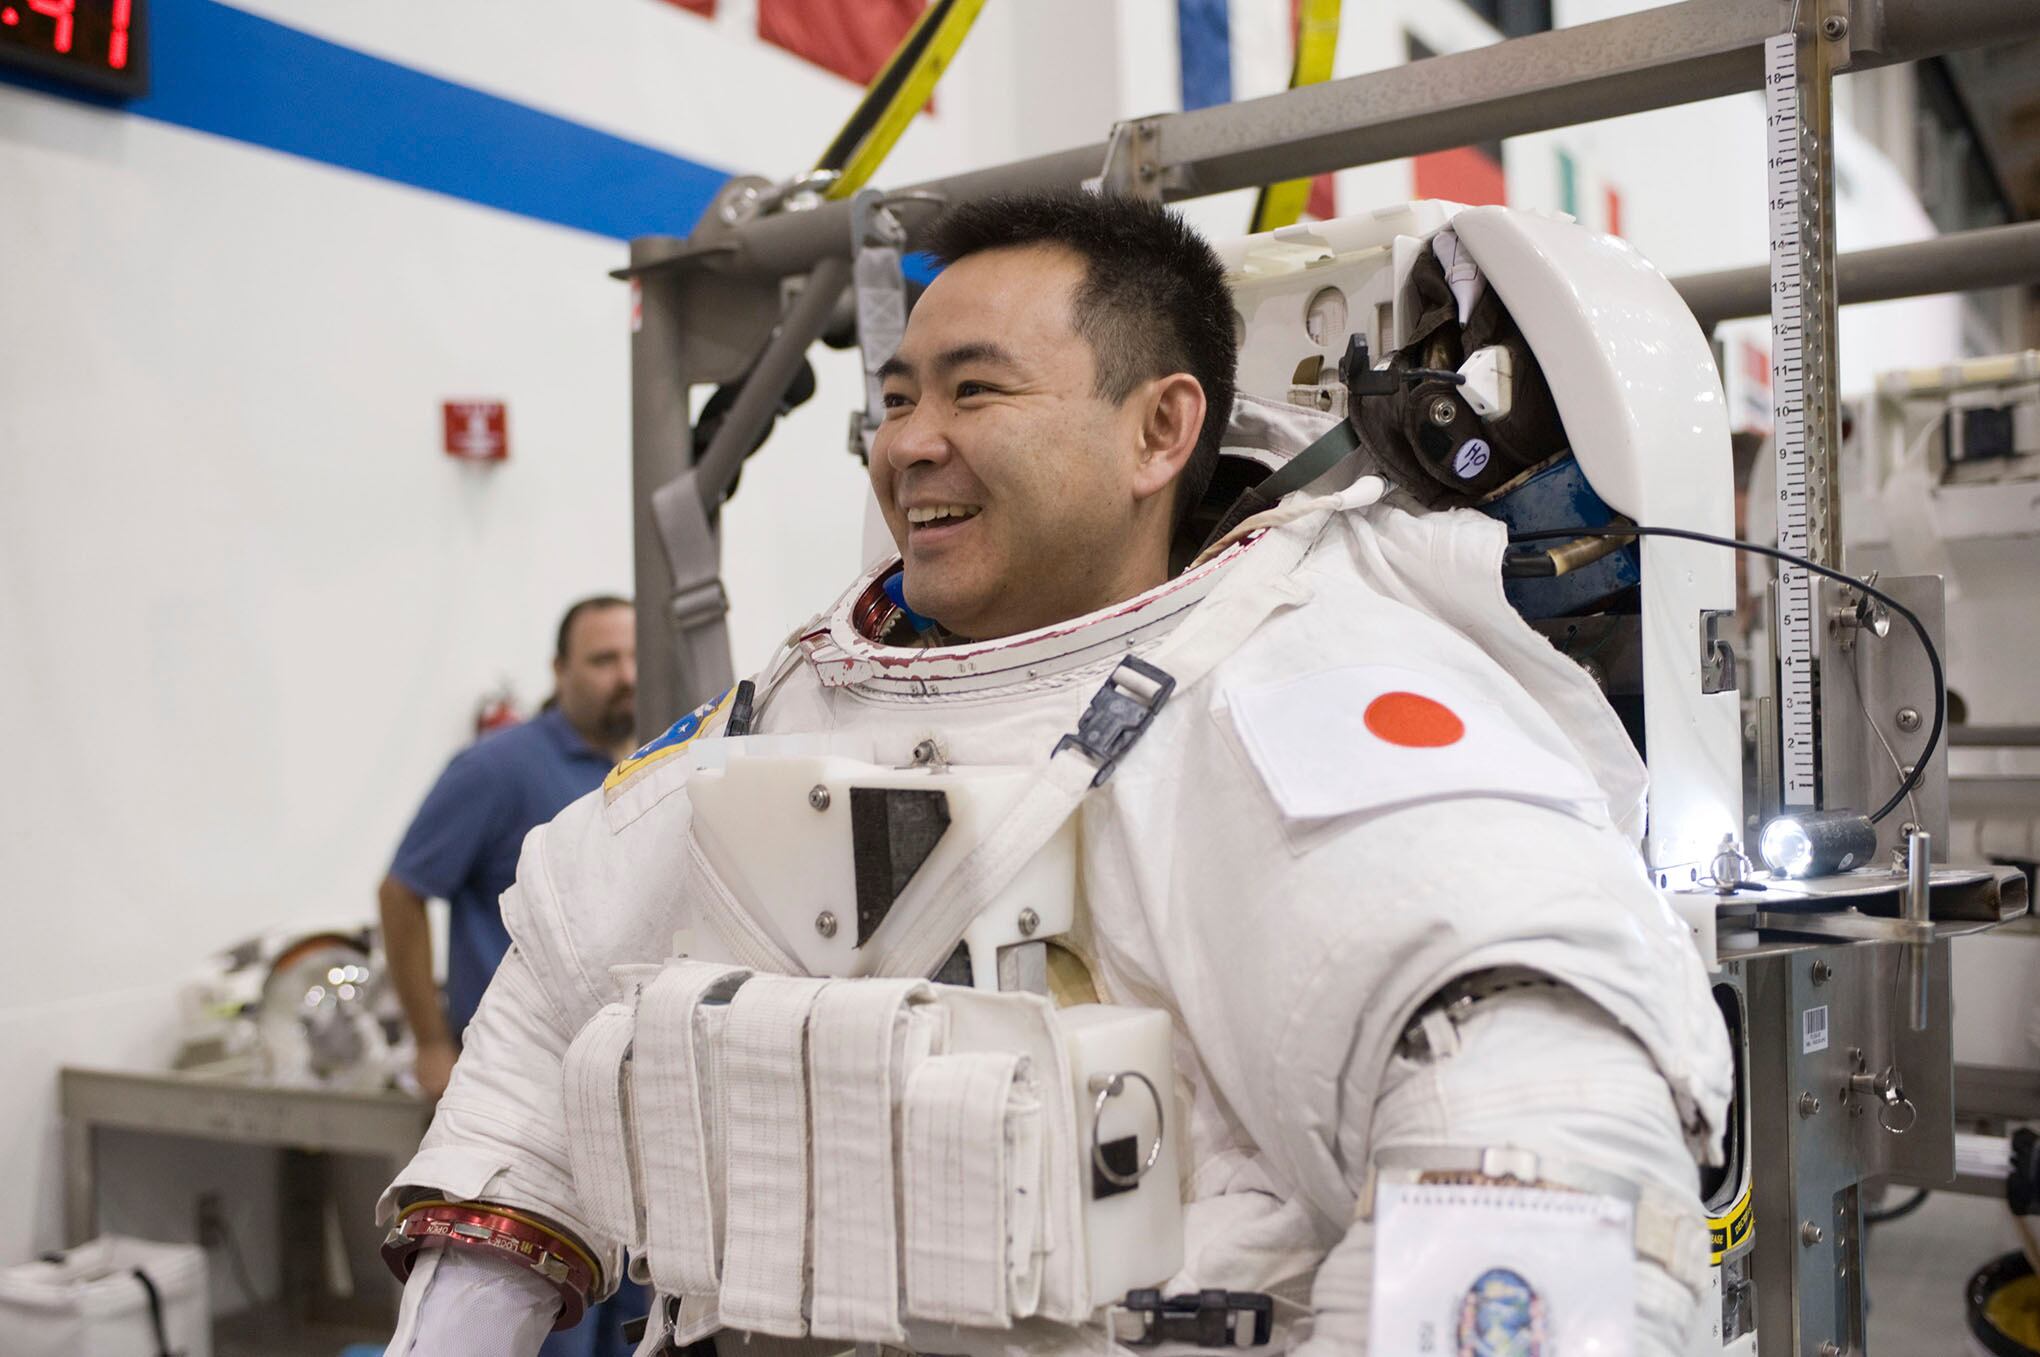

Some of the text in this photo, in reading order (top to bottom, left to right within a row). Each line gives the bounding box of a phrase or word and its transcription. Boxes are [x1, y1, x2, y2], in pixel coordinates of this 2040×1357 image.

[1767, 73, 1781, 85] 18
[1768, 115, 1782, 127] 17
[1769, 157, 1783, 169] 16
[1770, 199, 1784, 210] 15
[1772, 240, 1785, 251] 14
[1772, 282, 1787, 293] 13
[1774, 324, 1787, 335] 12
[1774, 365, 1787, 377] 11
[1776, 406, 1790, 418] 10
[1779, 448, 1787, 460] 9
[1780, 490, 1788, 501] 8
[1781, 531, 1789, 543] 7
[1782, 573, 1790, 584] 6
[1783, 615, 1791, 626] 5
[1785, 656, 1793, 667] 4
[1786, 698, 1794, 709] 3
[1787, 738, 1795, 749] 2
[1789, 780, 1794, 791] 1
[426, 1225, 449, 1234] OPEN
[494, 1238, 518, 1252] LOCK
